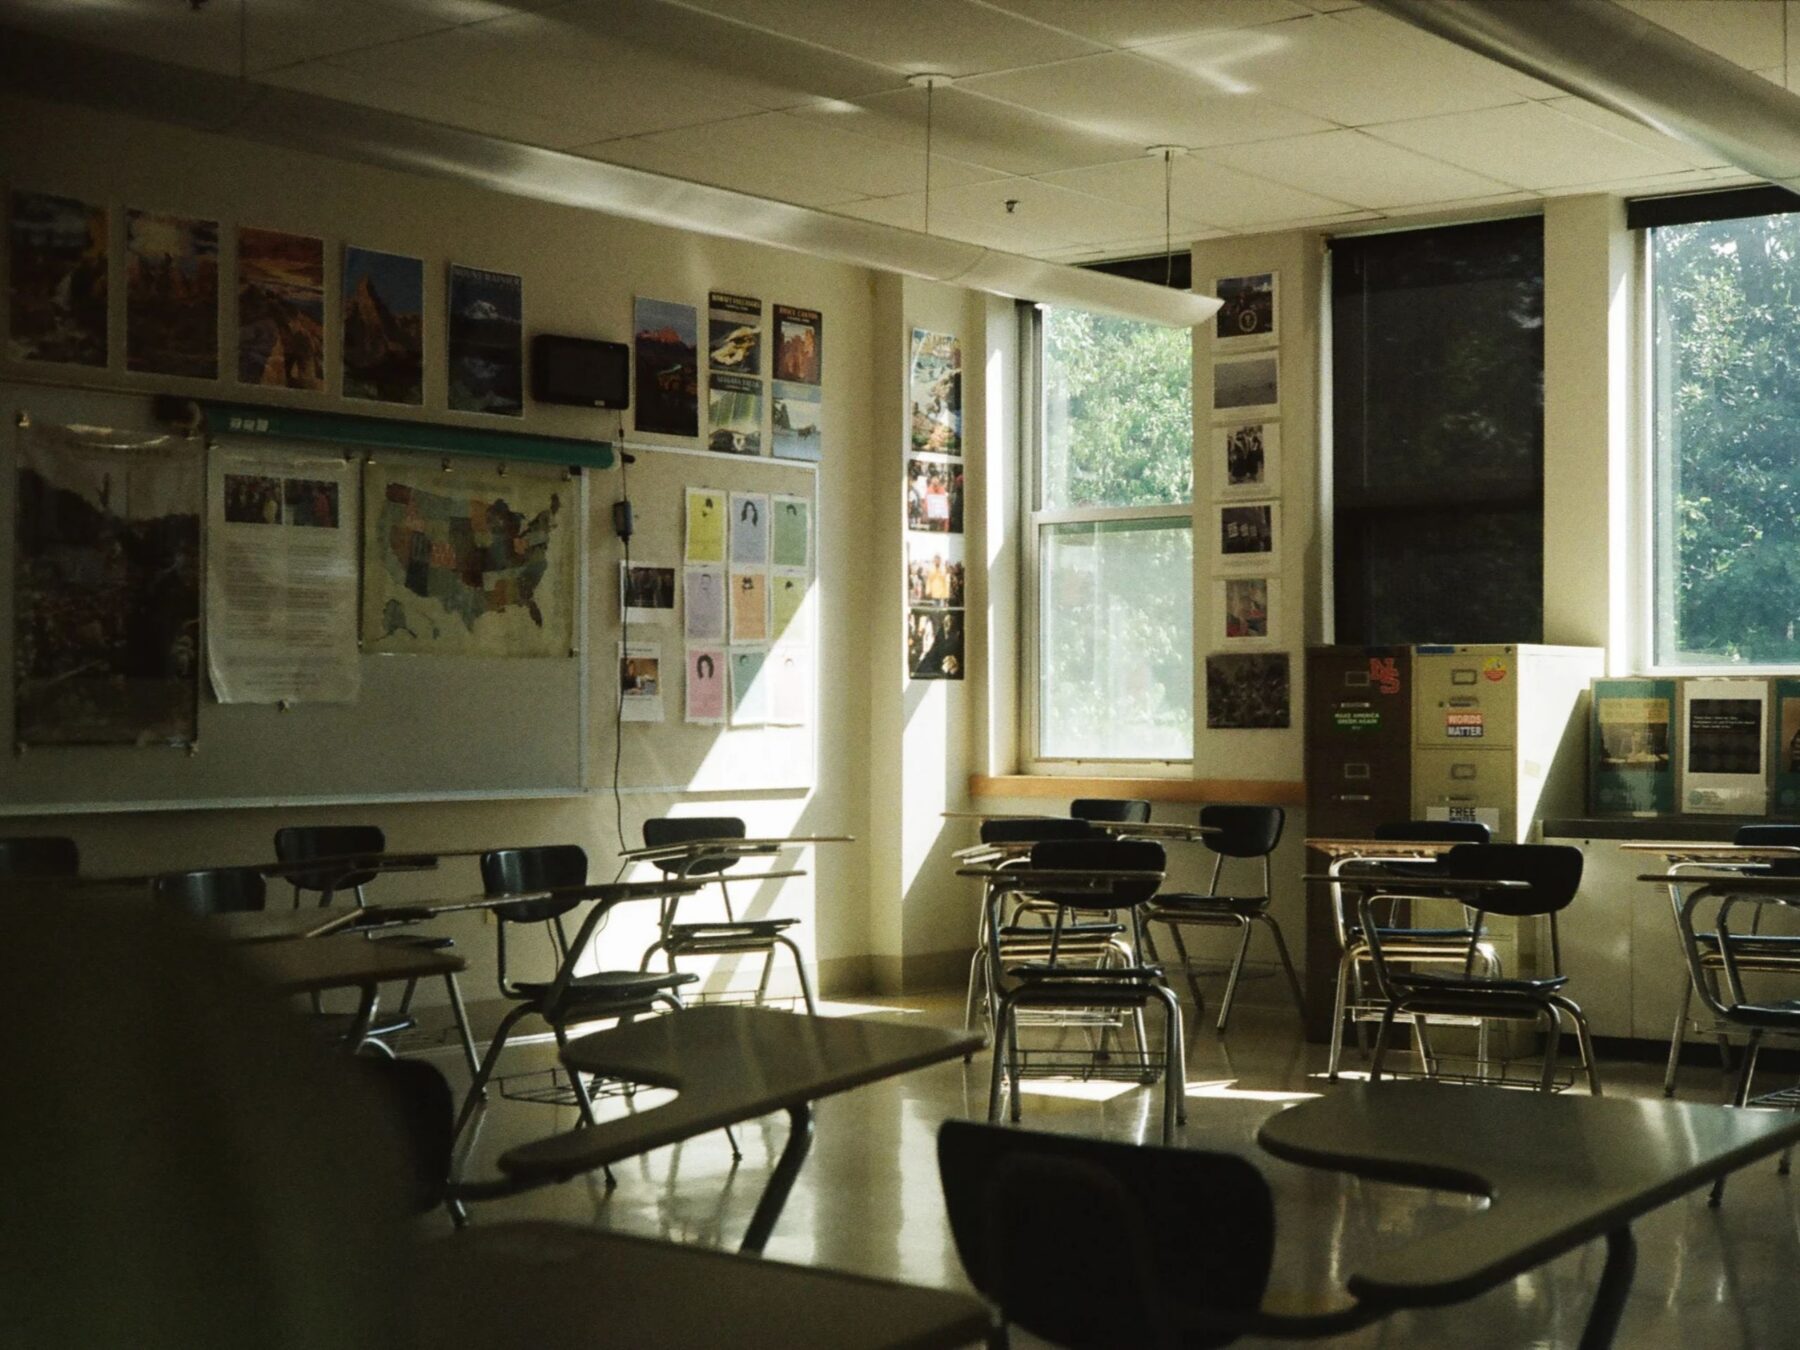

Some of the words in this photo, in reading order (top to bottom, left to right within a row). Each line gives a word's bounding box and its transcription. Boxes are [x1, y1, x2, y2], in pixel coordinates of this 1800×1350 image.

[1448, 714, 1481, 725] WORDS
[1448, 726, 1482, 736] MATTER
[1449, 806, 1476, 817] FREE
